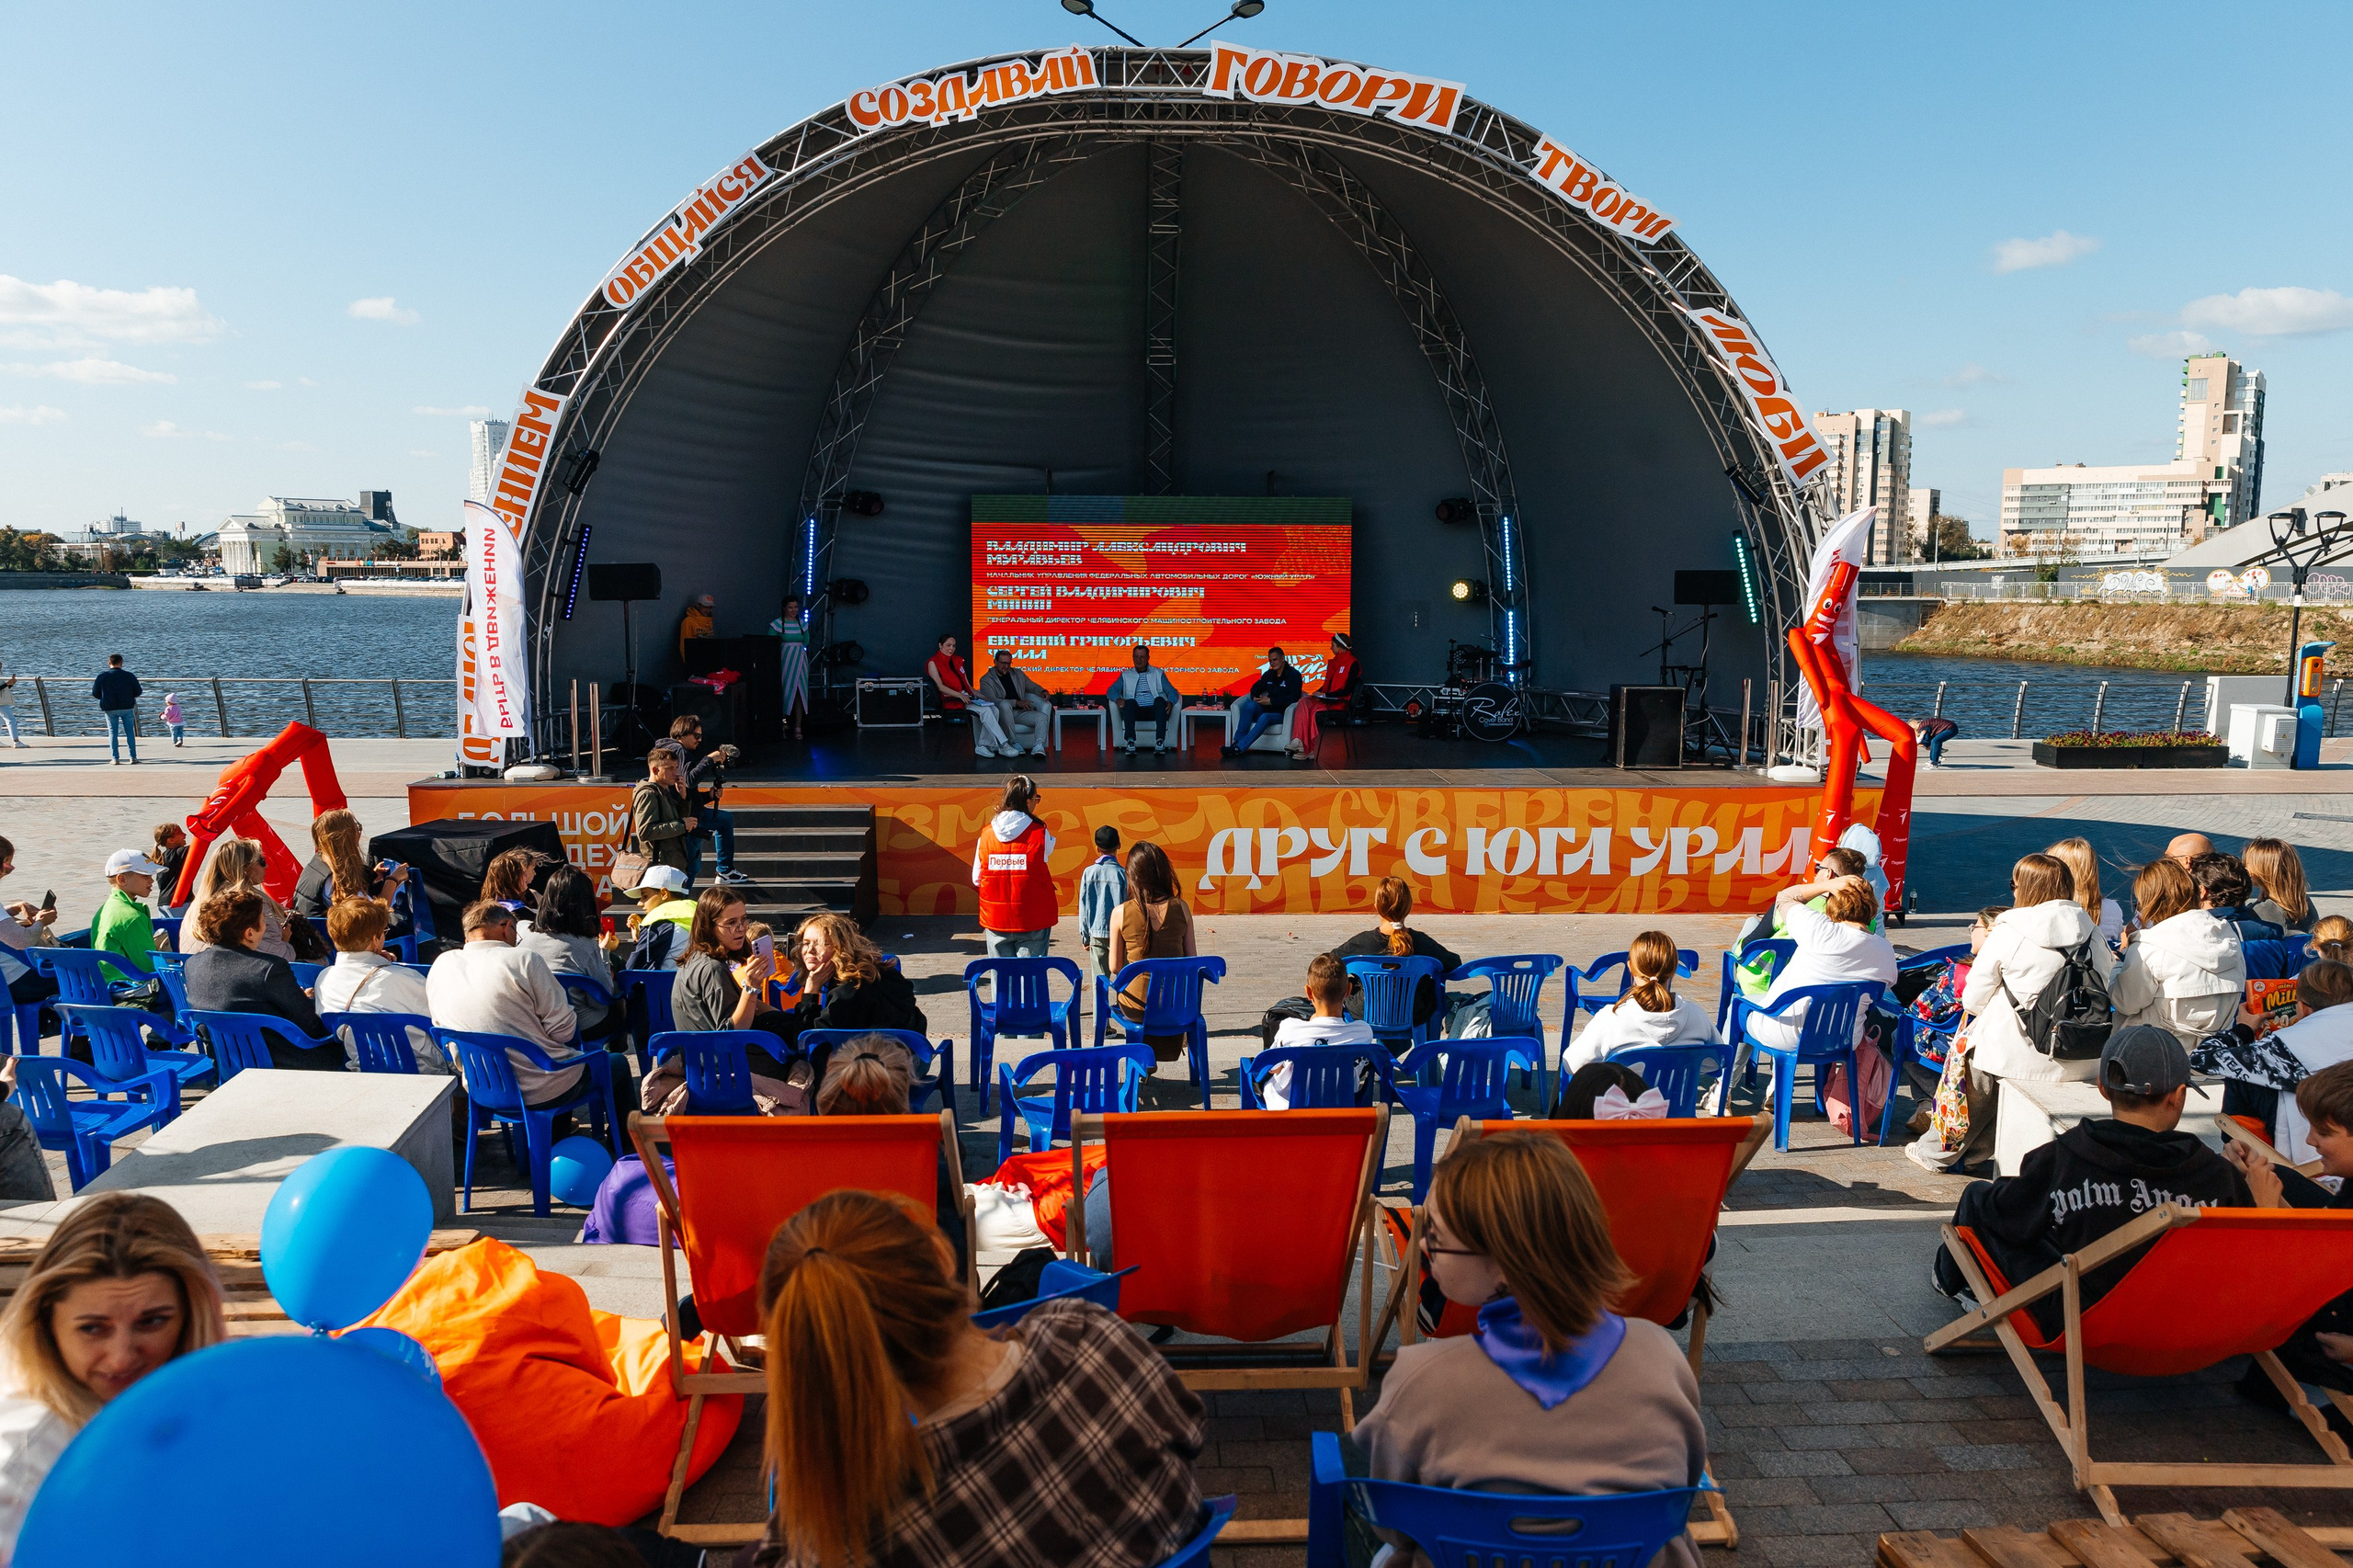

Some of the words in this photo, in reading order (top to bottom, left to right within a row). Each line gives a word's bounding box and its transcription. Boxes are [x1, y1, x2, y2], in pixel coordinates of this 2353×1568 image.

[849, 46, 1096, 125] СОЗДАВАЙ
[1211, 47, 1459, 127] ГОВОРИ
[1538, 141, 1673, 239] ТВОРИ
[607, 154, 767, 306] ОБЩАЙСЯ
[1699, 313, 1828, 480] ЛЮБИ
[987, 540, 1088, 554] ВЛАДИМИР
[1092, 540, 1246, 555] АЛЕКСАНДРОВИЧ
[1088, 572, 1148, 580] ФЕДЕРАЛЬНЫХ
[1149, 572, 1221, 580] АВТОМОБИЛЬНЫХ
[987, 584, 1052, 597] СЕРГЕЙ
[1056, 585, 1205, 599] ВЛАДИМИРОВИЧ
[987, 633, 1066, 646] ЕВГЕНИЙ
[1069, 635, 1196, 647] ГРИГОРЬЕВИЧ
[989, 858, 1025, 868] Первые
[1199, 826, 1387, 890] ДРУГ
[1404, 827, 1448, 876] С
[1465, 826, 1613, 876] ЮГА
[1630, 825, 1813, 877] УРАЛ
